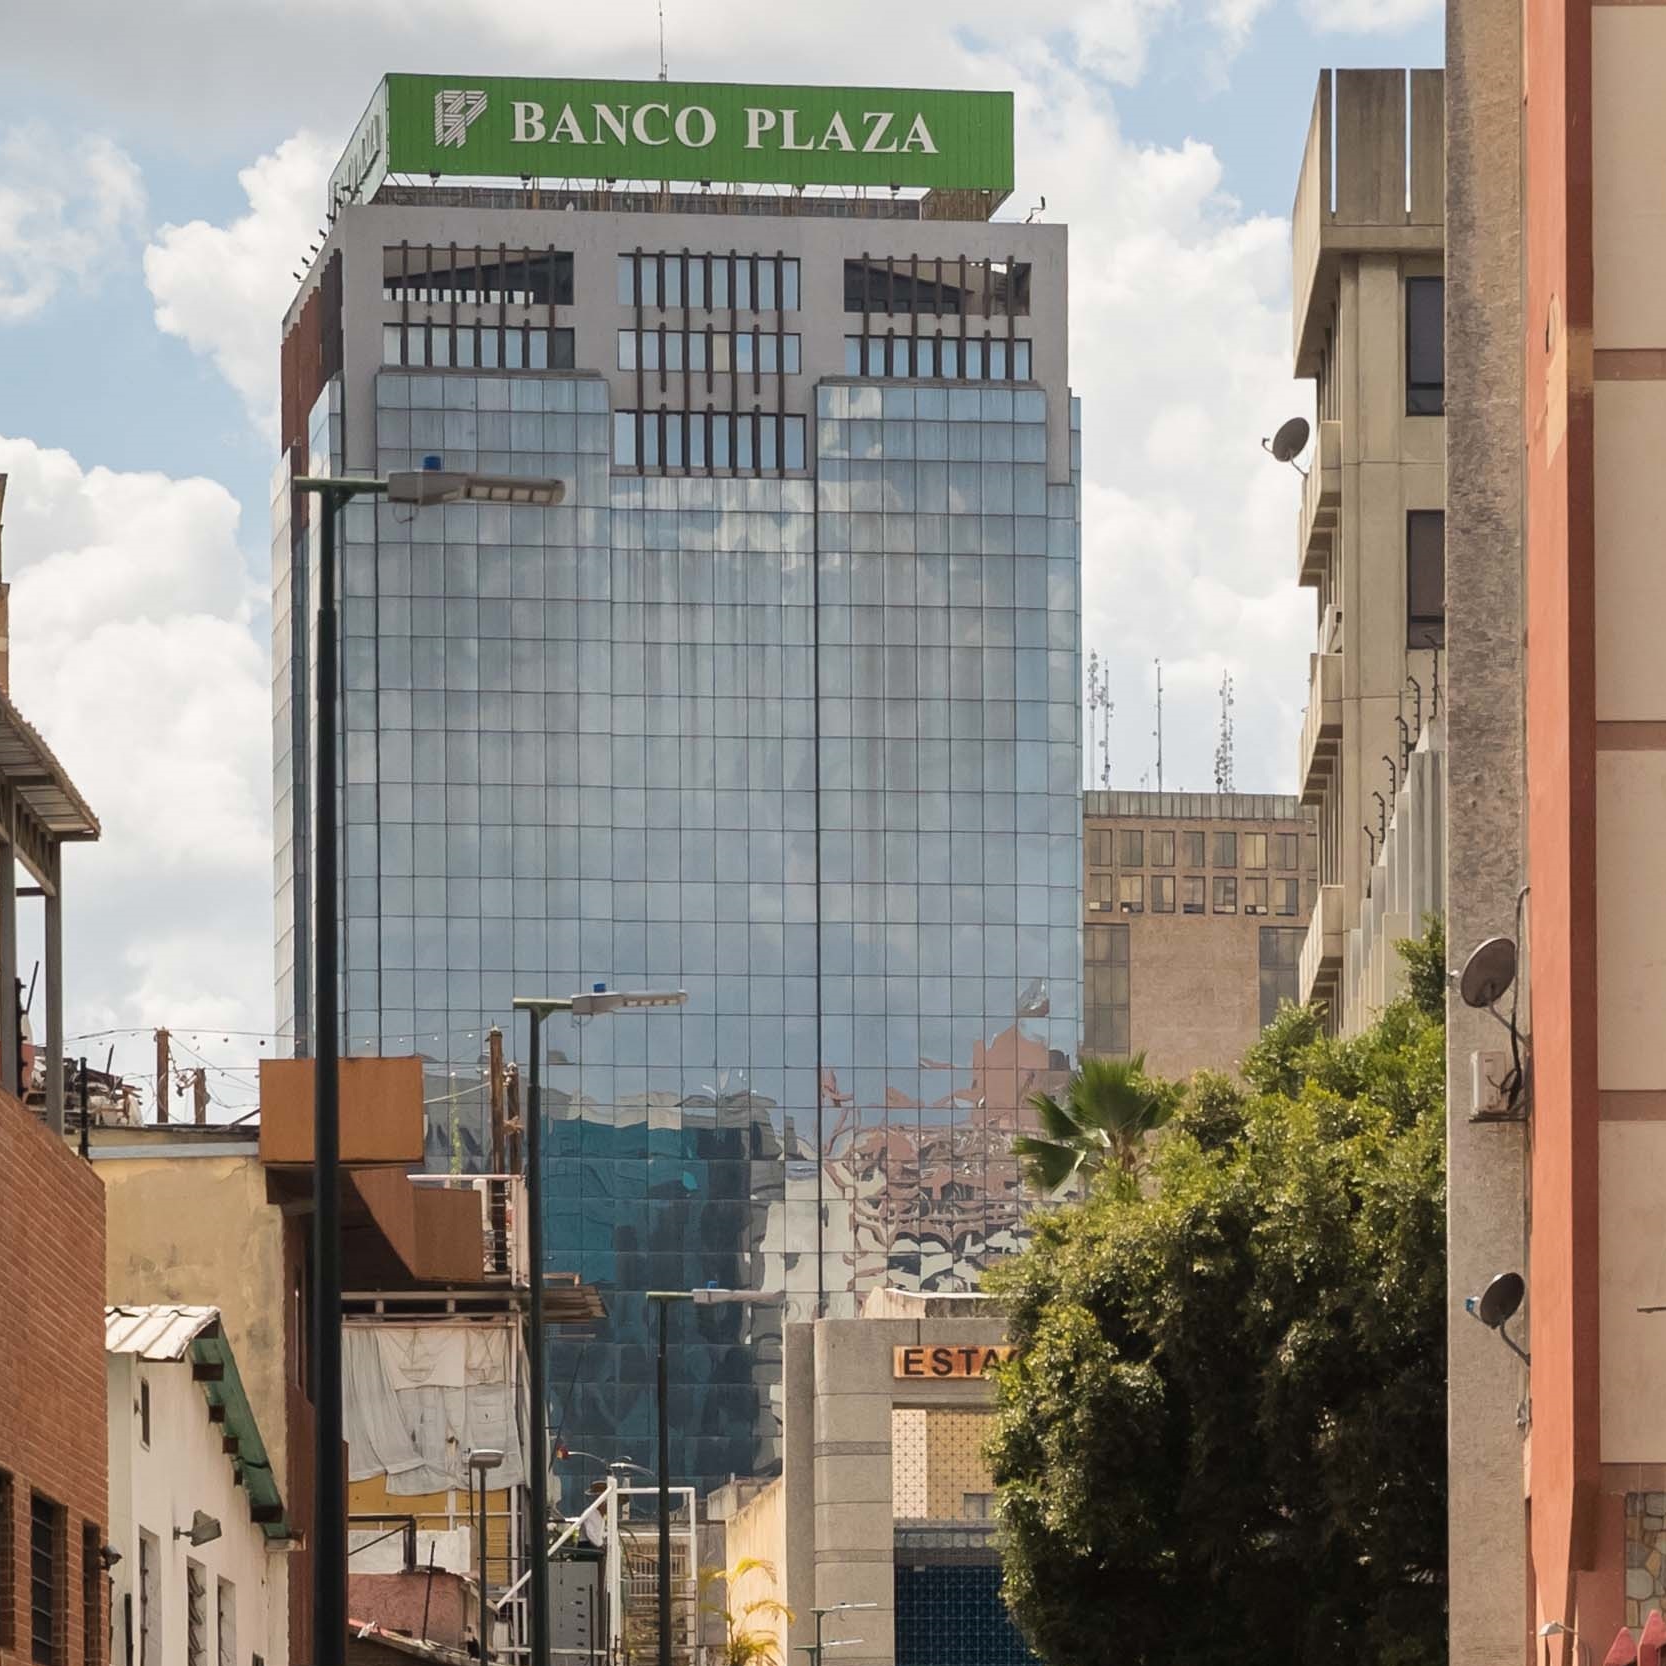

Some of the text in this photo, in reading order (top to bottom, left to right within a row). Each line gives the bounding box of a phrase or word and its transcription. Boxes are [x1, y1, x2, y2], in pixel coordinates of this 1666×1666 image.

[509, 101, 940, 155] BANCO PLAZA
[903, 1348, 1020, 1377] ESTA
